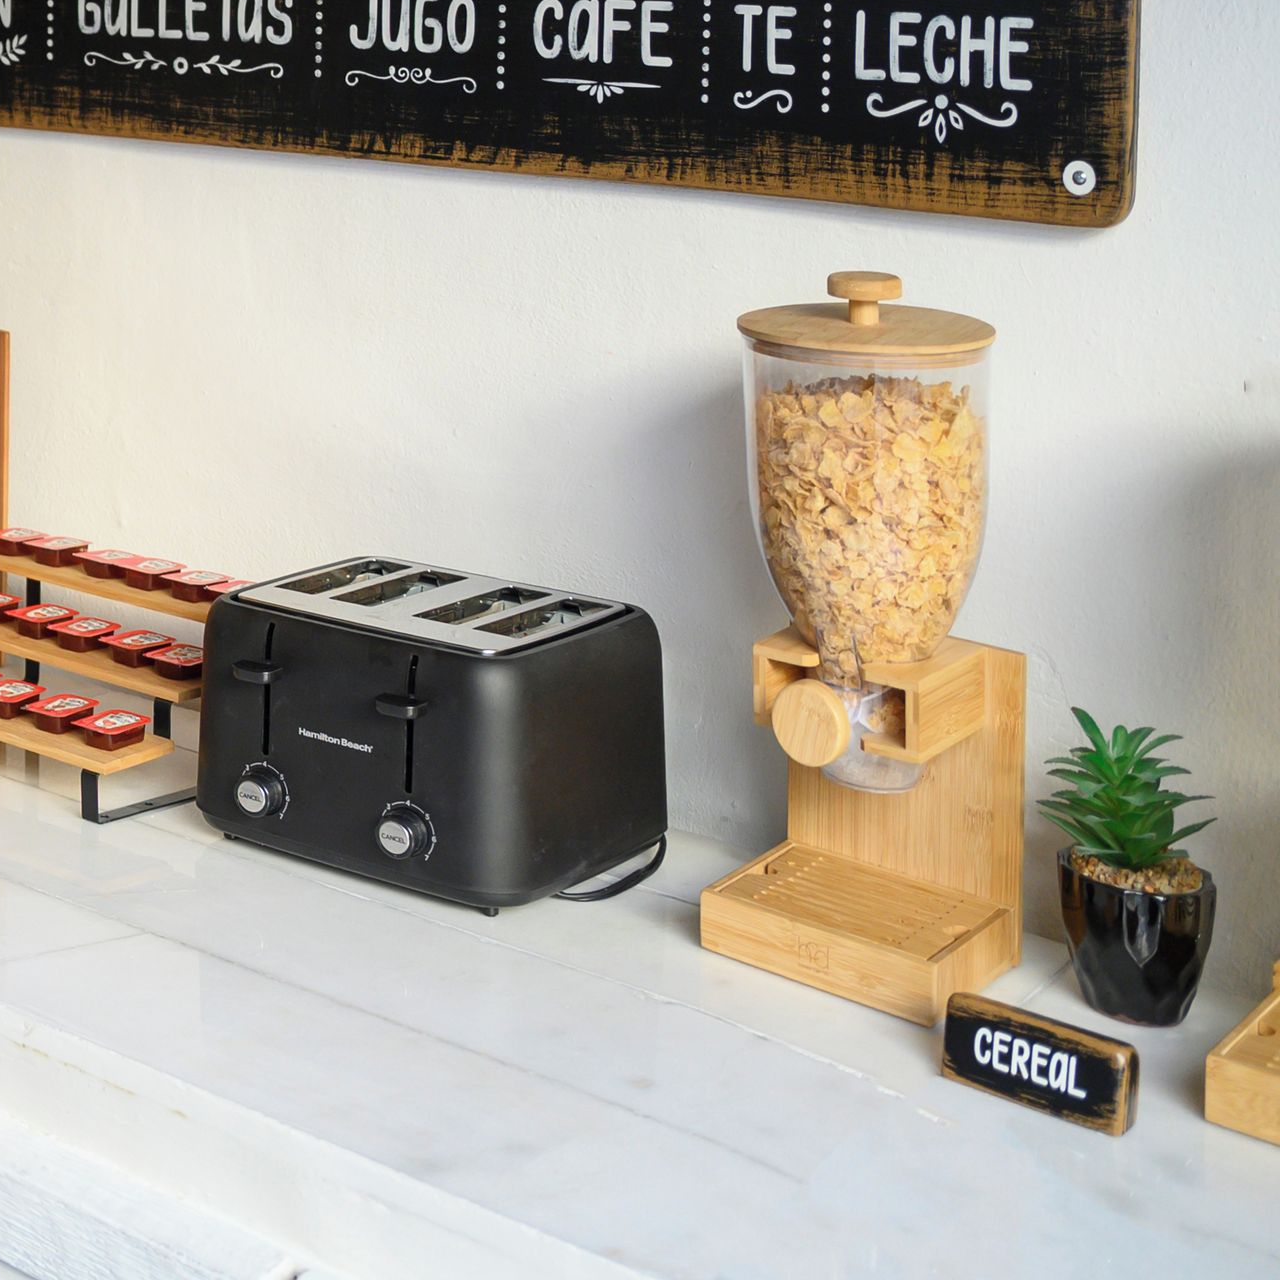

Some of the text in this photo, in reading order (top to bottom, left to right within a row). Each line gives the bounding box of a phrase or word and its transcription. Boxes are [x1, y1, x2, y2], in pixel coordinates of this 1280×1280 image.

[733, 4, 797, 76] TE
[854, 11, 1036, 93] LECHE
[298, 727, 340, 746] Hamilton
[239, 792, 262, 802] CANCEL
[381, 833, 406, 844] CANCEL
[973, 1026, 1088, 1100] CEREAL
